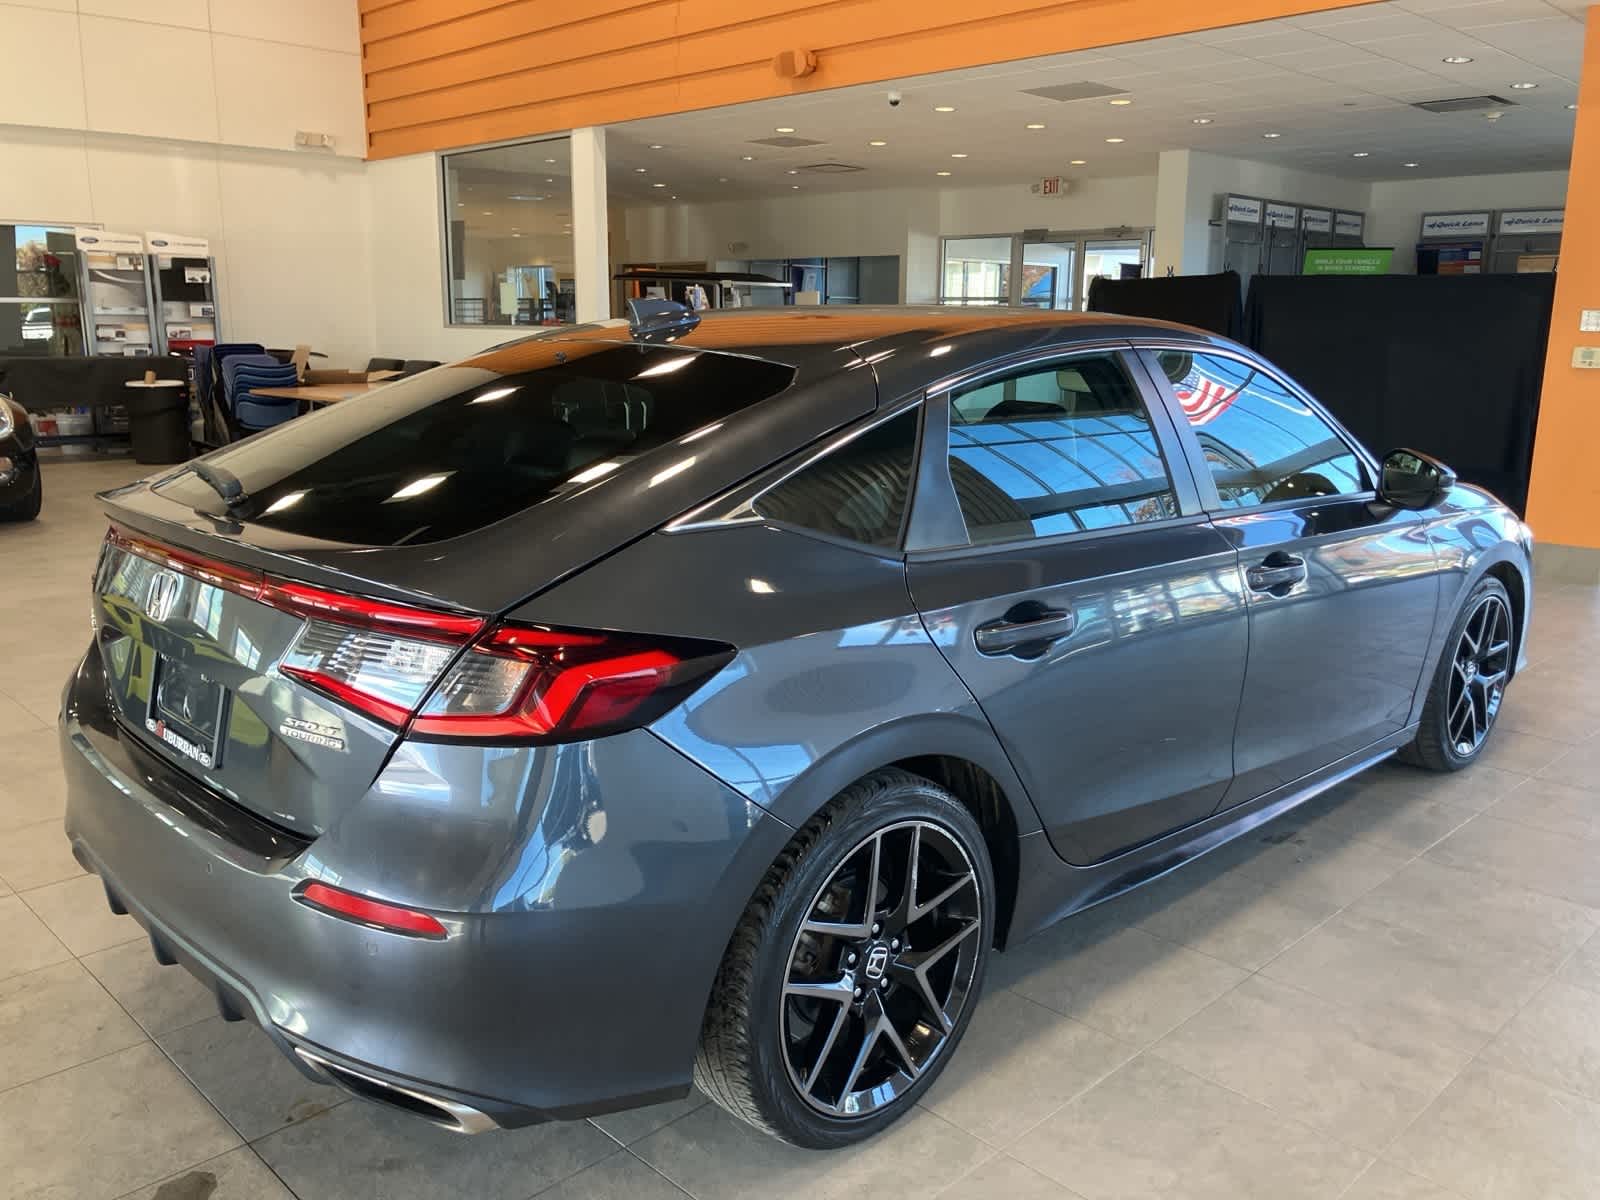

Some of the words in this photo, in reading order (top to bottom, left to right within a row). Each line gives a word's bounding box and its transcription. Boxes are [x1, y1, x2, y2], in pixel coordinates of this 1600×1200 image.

[1043, 177, 1059, 194] EXIT
[1437, 220, 1460, 228] Quick
[1515, 217, 1540, 225] Quick
[155, 719, 199, 760] SUBURBAN
[280, 725, 343, 751] TOURING
